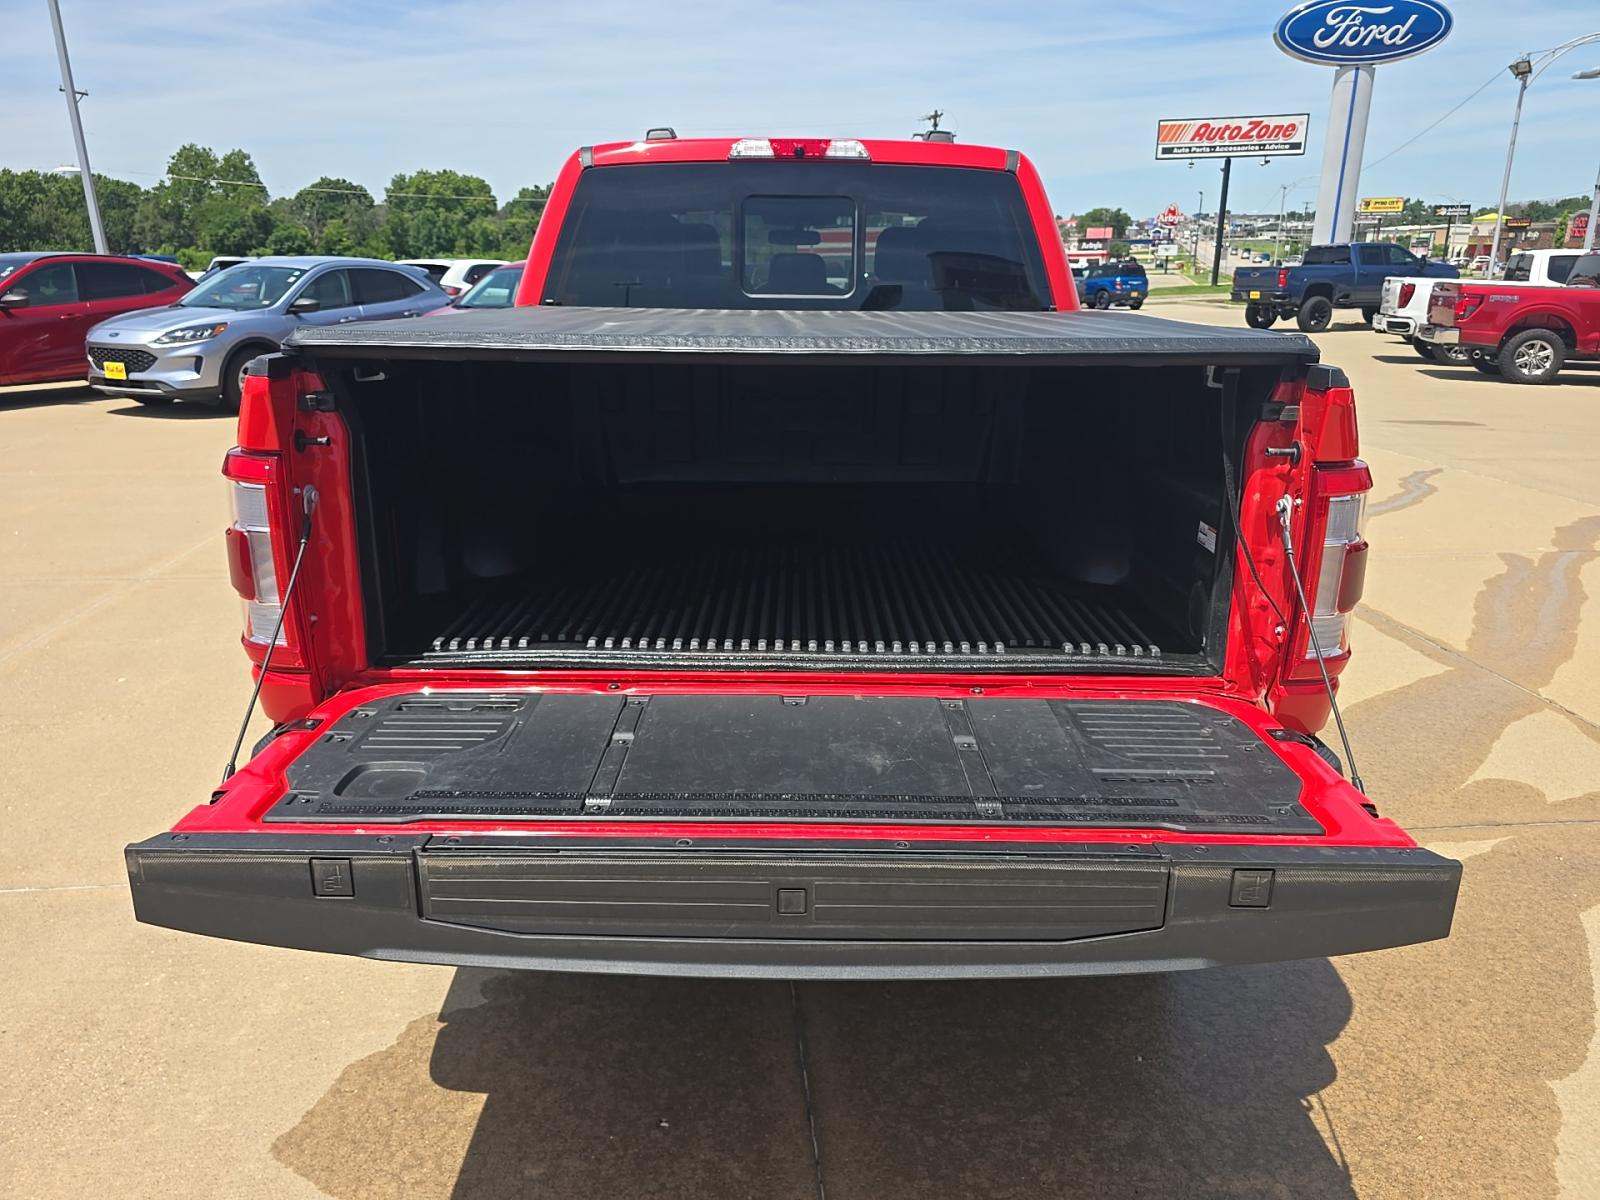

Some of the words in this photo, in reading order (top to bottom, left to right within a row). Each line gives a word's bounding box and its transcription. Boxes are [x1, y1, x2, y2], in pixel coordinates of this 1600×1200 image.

[1313, 6, 1419, 48] Ford
[1189, 120, 1297, 142] AutoZone
[1082, 241, 1102, 250] Arby's
